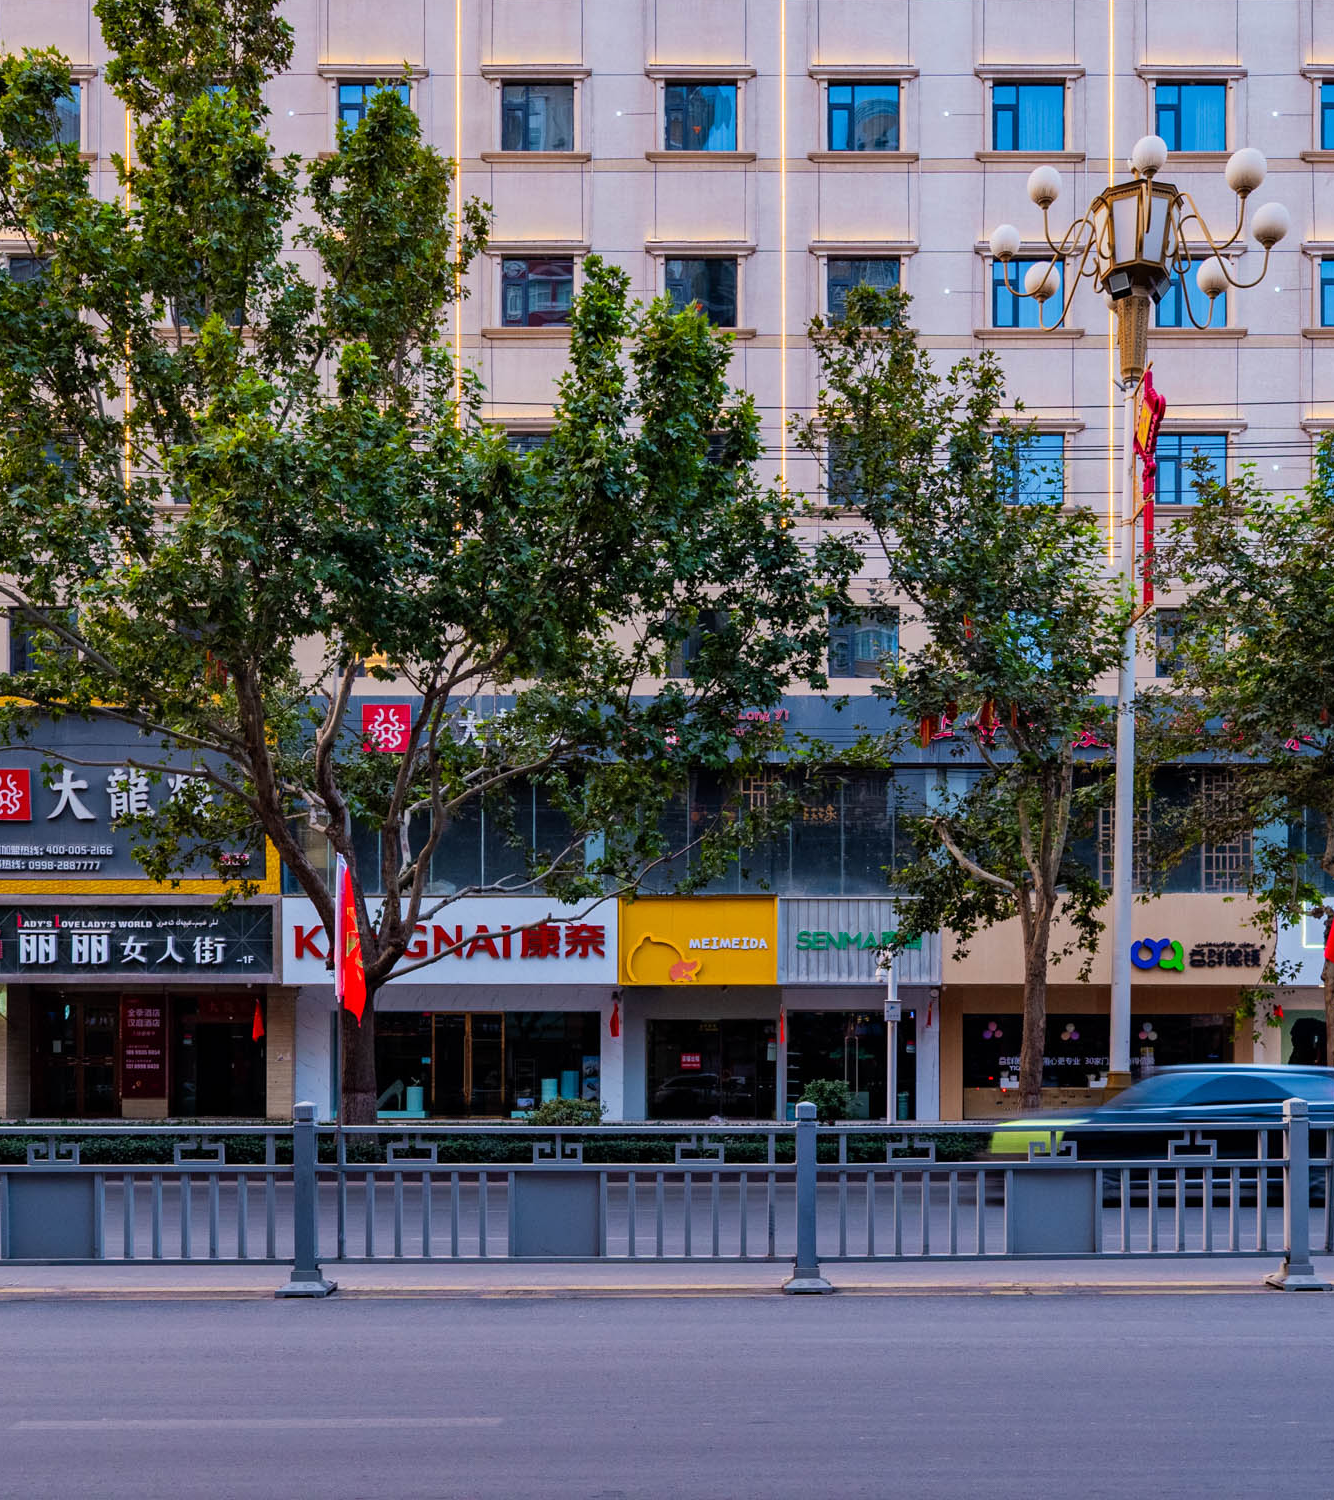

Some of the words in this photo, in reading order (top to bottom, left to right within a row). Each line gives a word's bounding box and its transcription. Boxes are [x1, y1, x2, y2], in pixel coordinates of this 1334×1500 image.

[46, 845, 113, 856] 400-005-2166
[28, 861, 100, 871] 0998-2887777
[18, 929, 227, 964] 丽丽女人街
[293, 924, 511, 959] KGNAI
[520, 923, 605, 959] 康奈
[689, 937, 768, 950] MEIMEIDA
[127, 1008, 161, 1018] 全季酒店
[127, 1018, 161, 1028] 汉庭酒店
